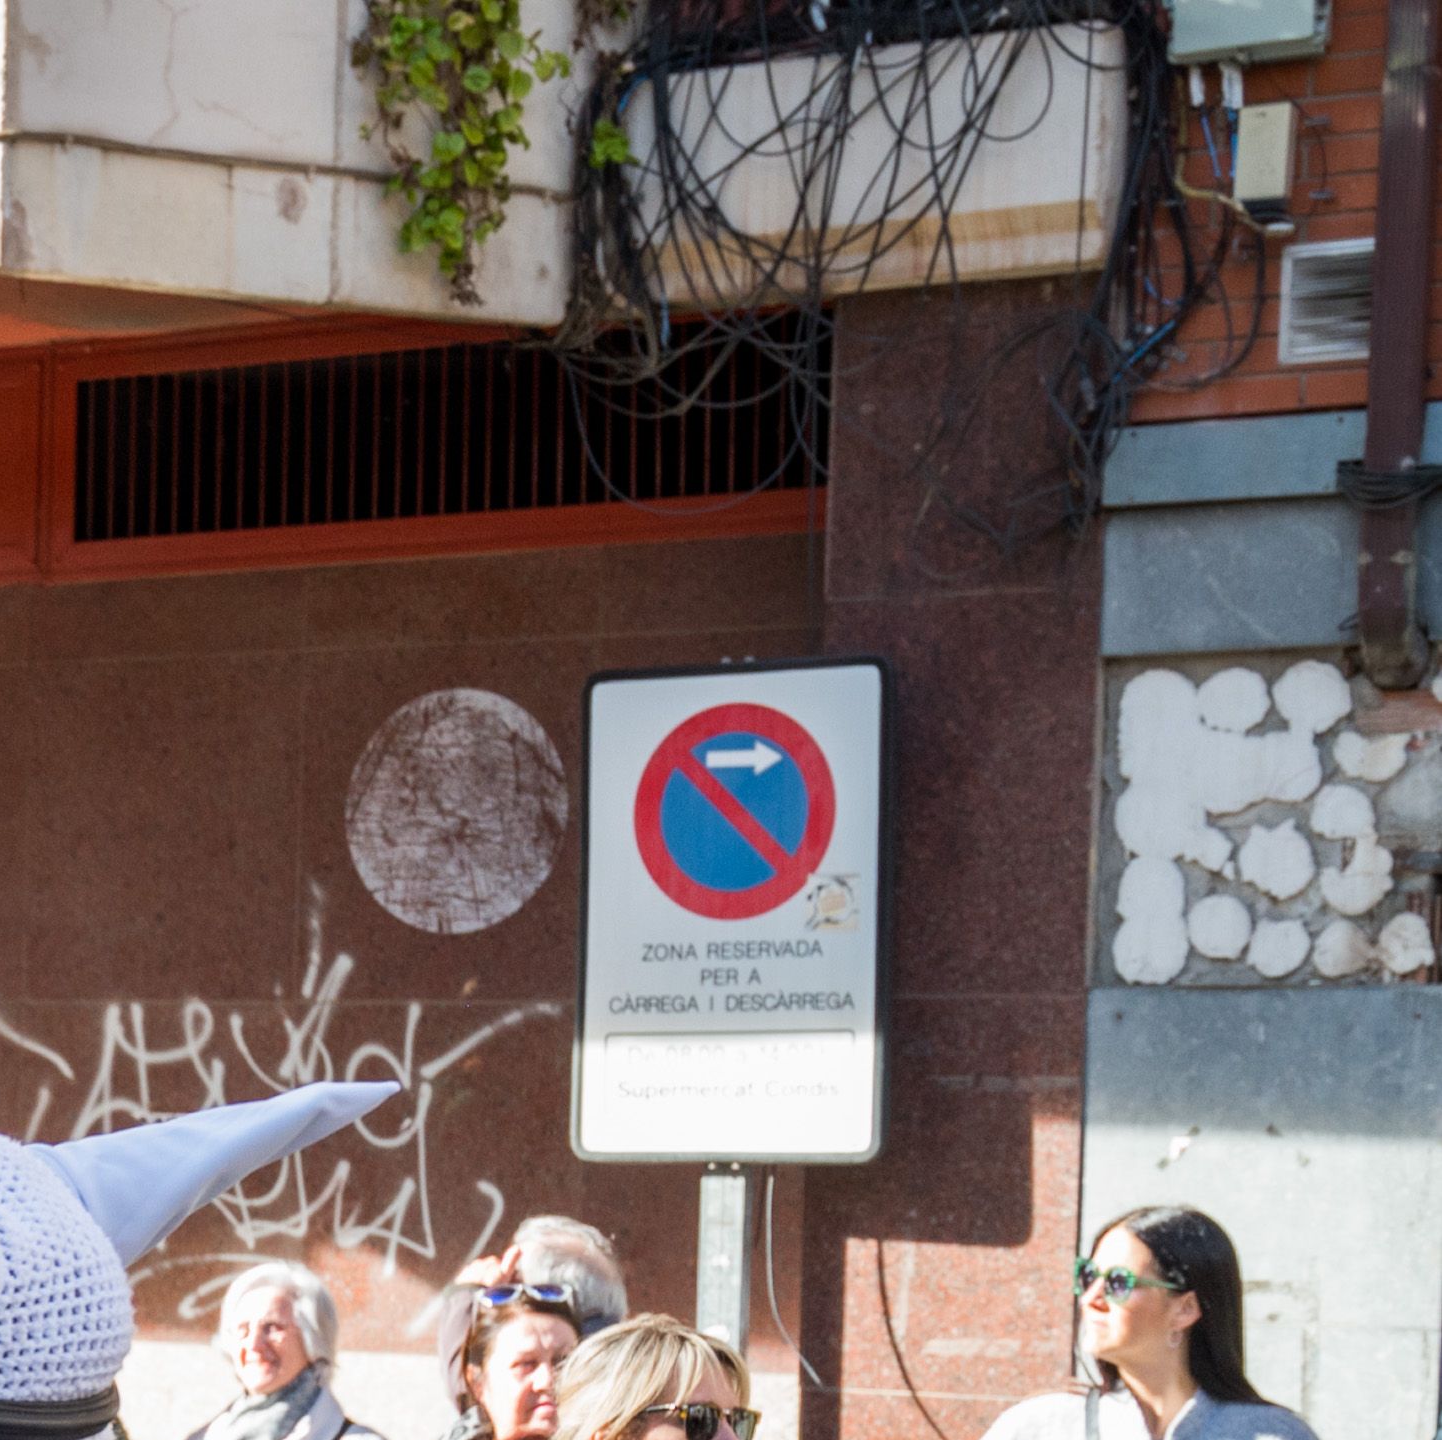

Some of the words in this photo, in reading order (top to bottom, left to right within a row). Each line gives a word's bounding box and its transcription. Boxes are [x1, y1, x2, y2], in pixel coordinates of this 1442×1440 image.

[642, 943, 698, 962] ZONA
[707, 939, 823, 960] RESERVADA
[700, 967, 739, 985] PER
[748, 967, 762, 985] A
[609, 993, 699, 1014] CÀRREGA
[708, 995, 715, 1012] I
[725, 990, 855, 1013] DESCÀRREGA
